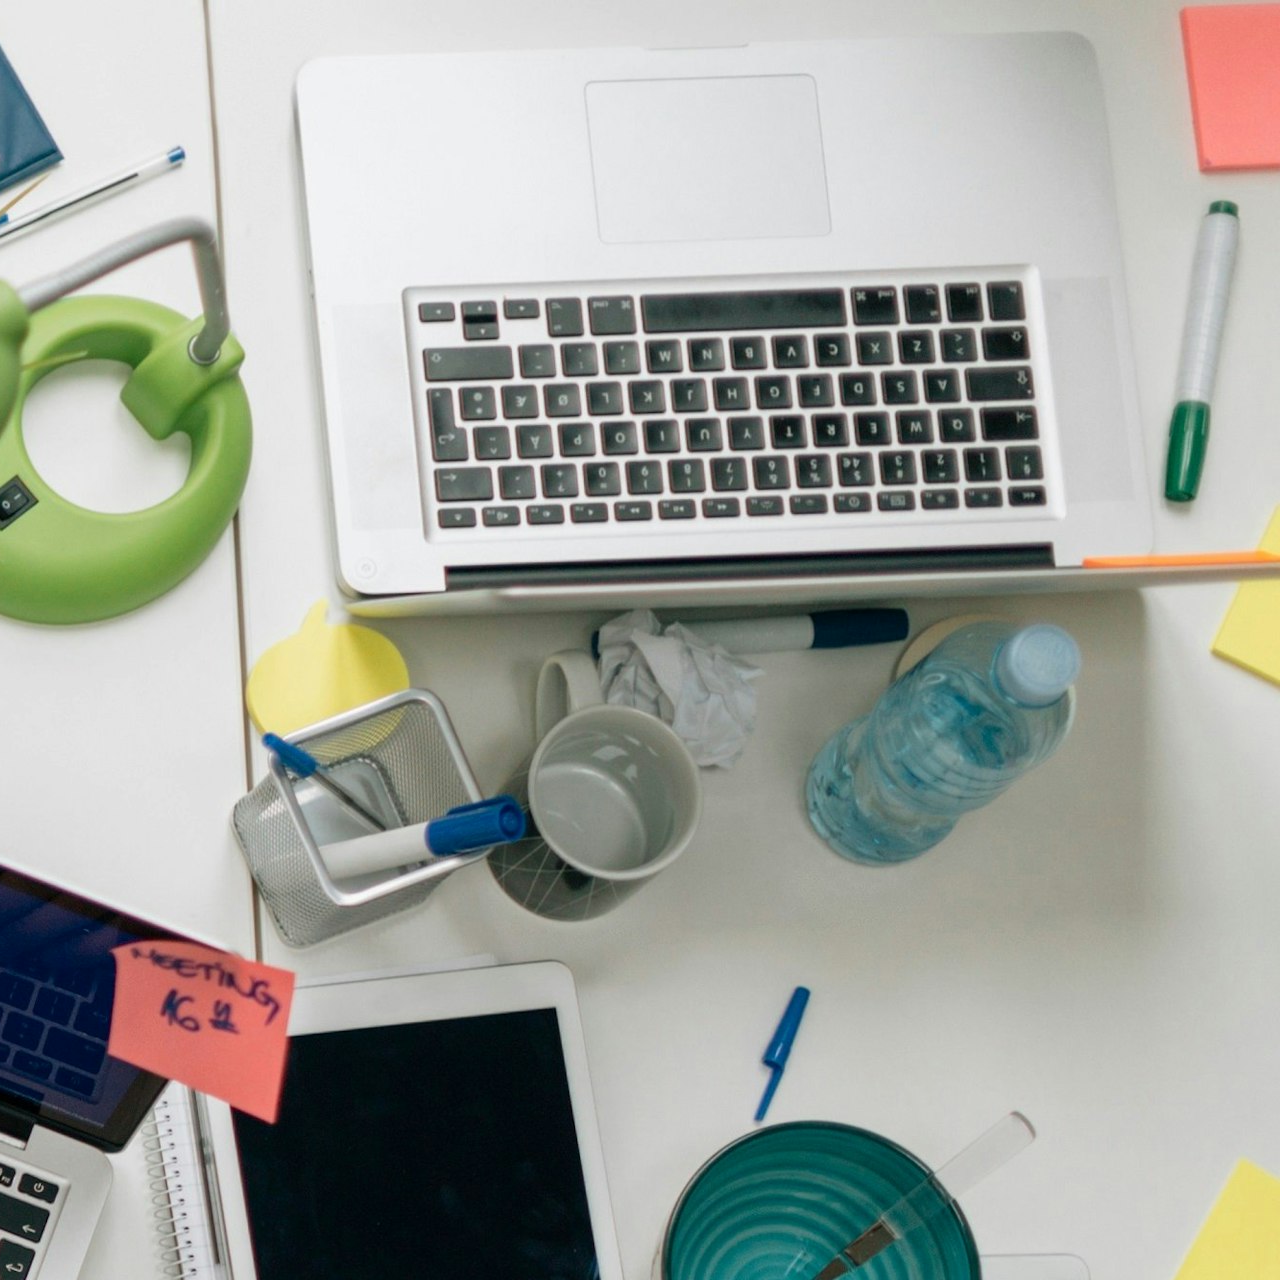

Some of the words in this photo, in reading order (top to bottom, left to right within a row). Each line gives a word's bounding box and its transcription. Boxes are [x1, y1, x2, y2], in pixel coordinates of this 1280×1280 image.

[744, 346, 754, 359] B
[786, 345, 797, 358] V
[828, 343, 839, 356] C
[870, 342, 880, 354] X
[912, 339, 922, 353] Z
[658, 350, 672, 363] M
[701, 348, 713, 361] N
[769, 385, 781, 399] G
[813, 384, 821, 397] F
[853, 381, 864, 395] D
[895, 380, 906, 393] S
[936, 379, 948, 392] A
[601, 392, 610, 404] L
[642, 391, 653, 403] K
[687, 389, 694, 402] J
[727, 388, 738, 400] H
[826, 423, 836, 437] R
[869, 421, 878, 435] E
[909, 420, 923, 433] W
[951, 418, 964, 431] Q
[614, 431, 626, 444] O
[699, 428, 711, 441] U
[743, 427, 752, 439] Y
[785, 425, 794, 438] T
[573, 433, 583, 446] P
